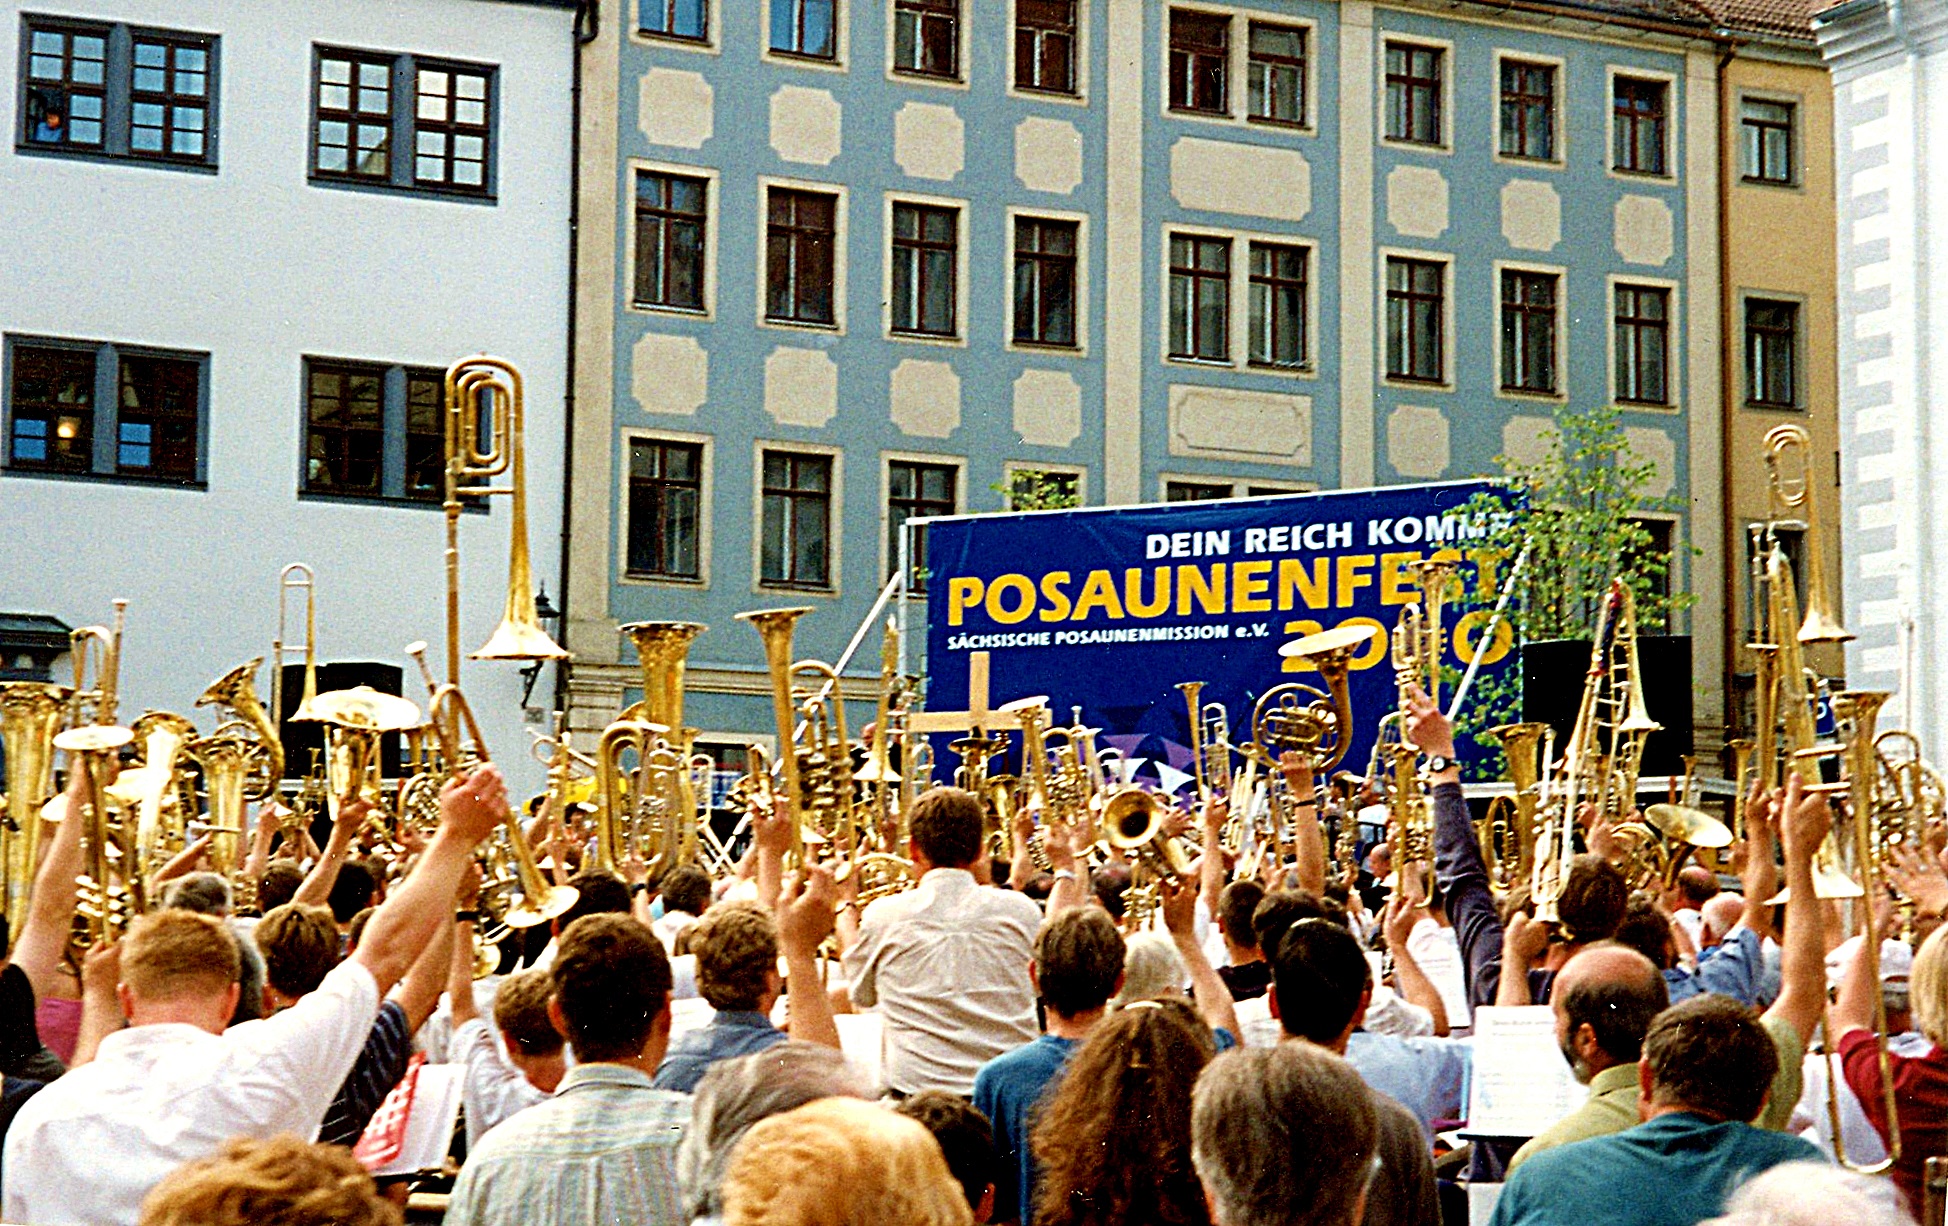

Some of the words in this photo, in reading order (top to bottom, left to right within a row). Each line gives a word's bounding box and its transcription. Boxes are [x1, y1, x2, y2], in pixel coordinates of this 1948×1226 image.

[1146, 529, 1230, 559] DEIN
[1245, 521, 1353, 553] REICH
[947, 632, 1051, 650] SÄCHSISCHE
[1055, 624, 1229, 645] POSAUNENMISSION
[1235, 622, 1270, 639] e.V.
[1281, 610, 1513, 673] 200
